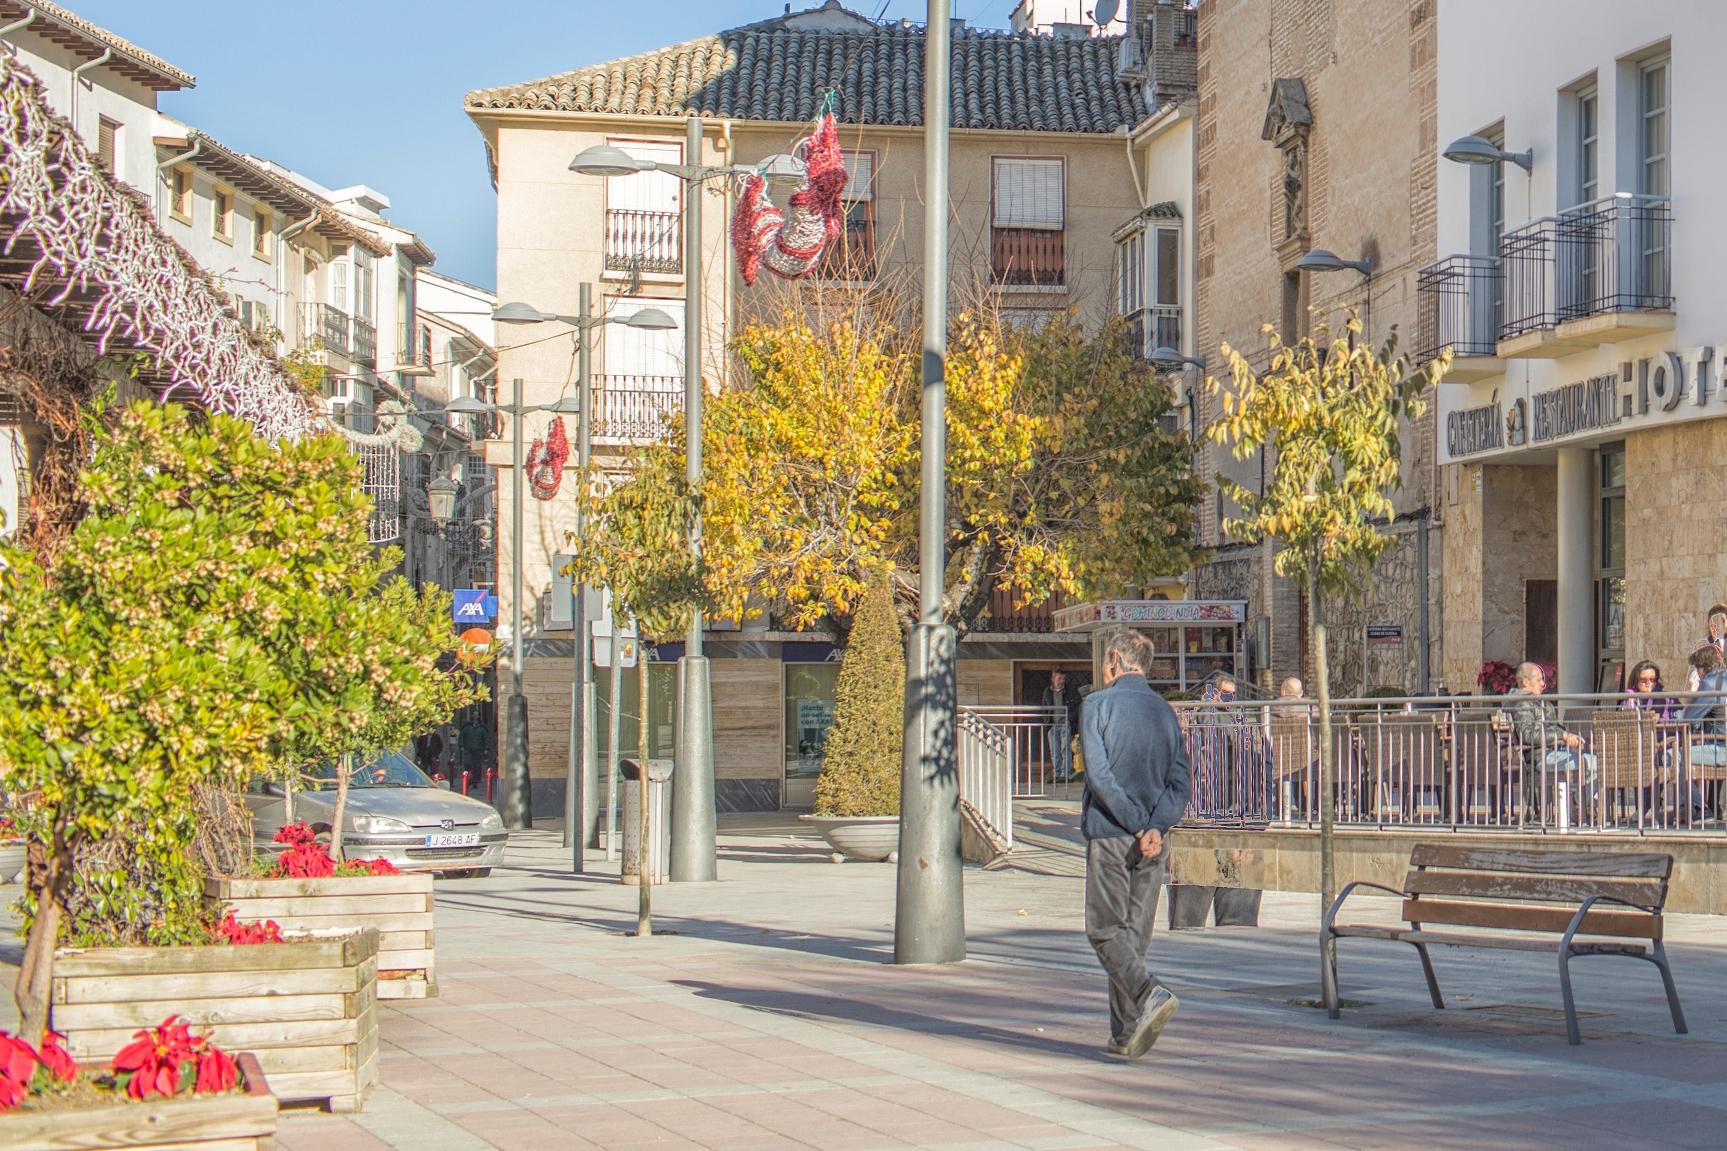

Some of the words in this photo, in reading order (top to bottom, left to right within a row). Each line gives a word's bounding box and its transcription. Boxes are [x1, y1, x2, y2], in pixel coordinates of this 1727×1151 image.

[1532, 374, 1622, 442] RESTAURANTE
[457, 602, 485, 616] AXA
[1124, 607, 1200, 619] GOMINOLNDIA
[433, 835, 439, 846] J
[441, 835, 463, 846] 2648
